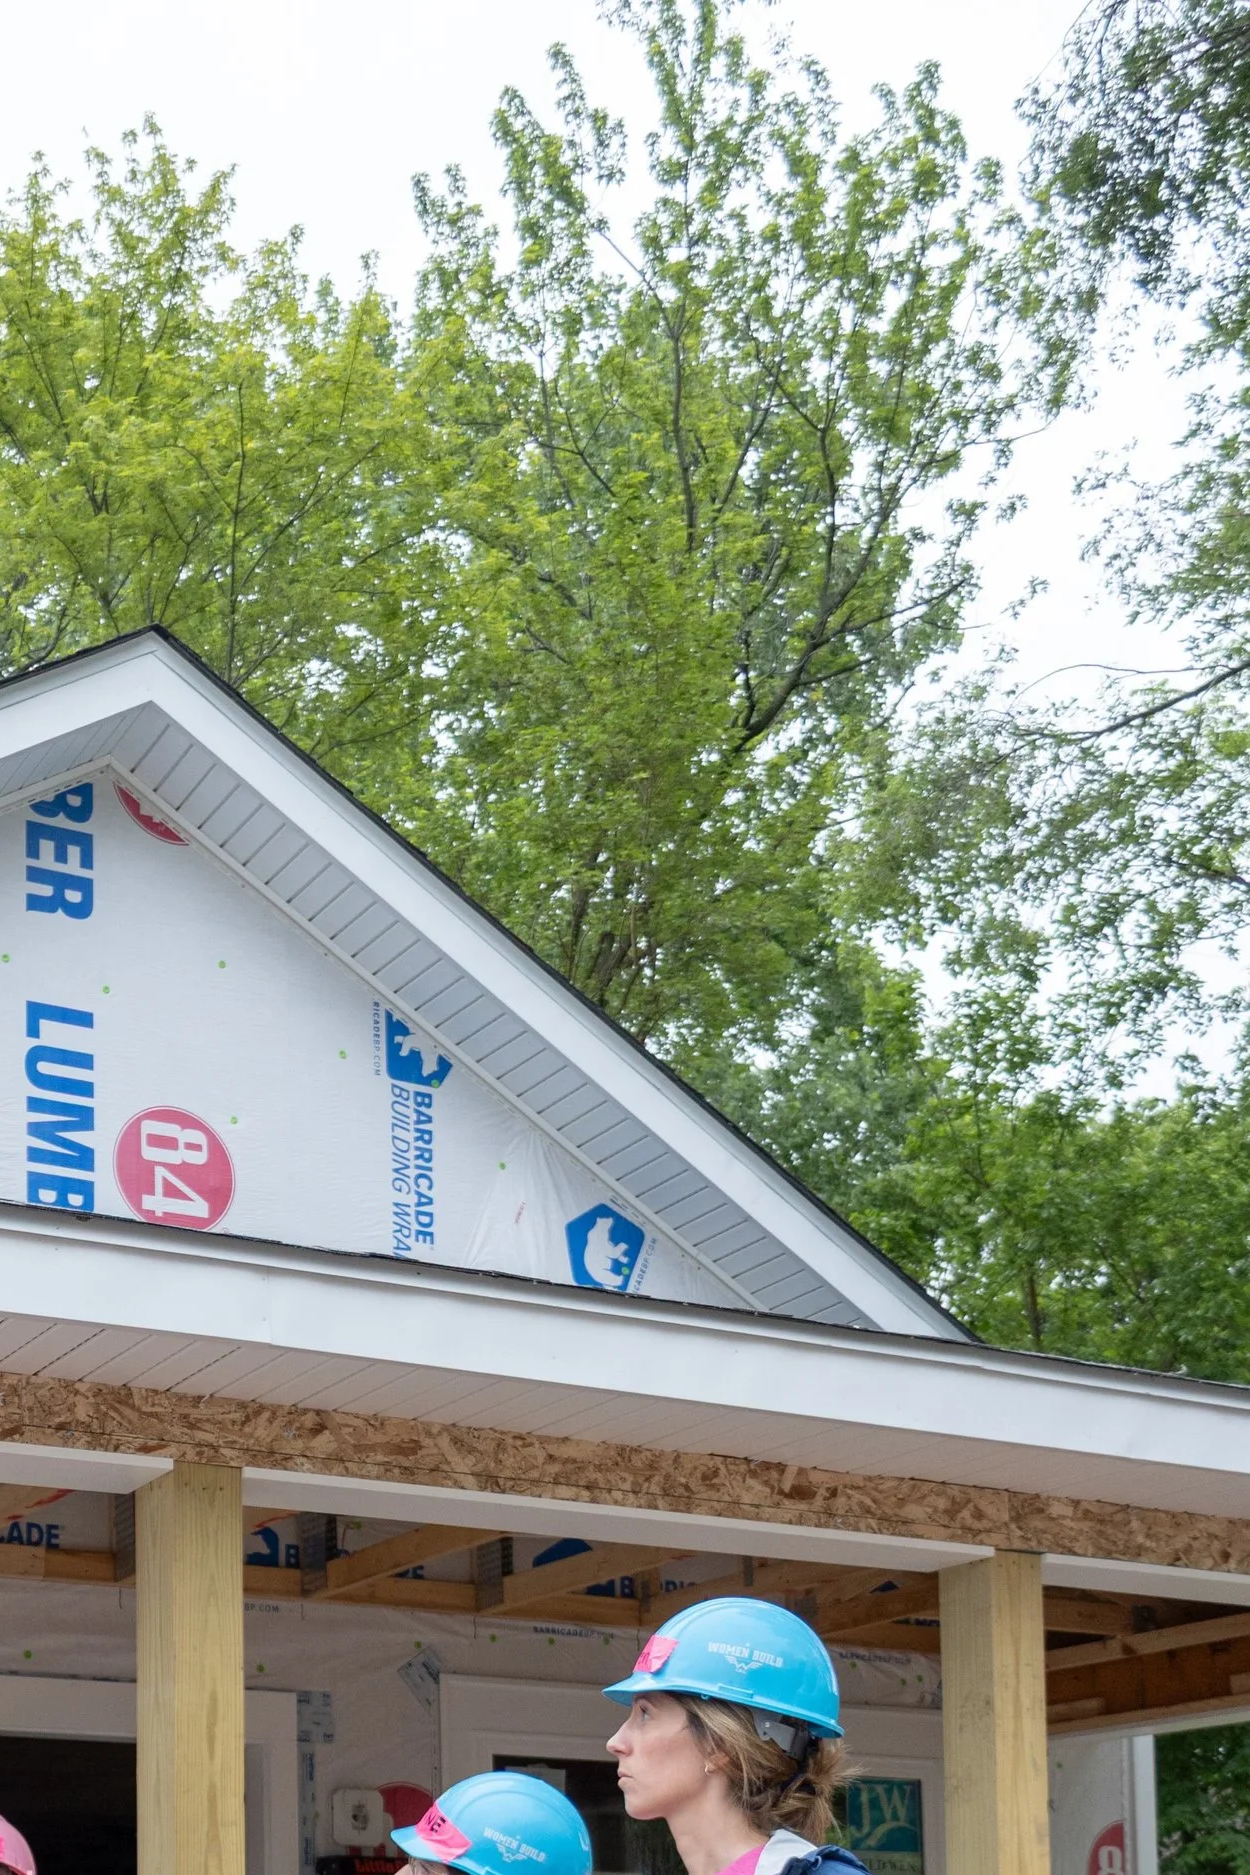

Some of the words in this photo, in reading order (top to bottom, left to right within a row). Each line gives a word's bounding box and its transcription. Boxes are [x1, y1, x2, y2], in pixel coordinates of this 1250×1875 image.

[26, 782, 93, 920] BER
[25, 1000, 94, 1213] LUMB
[391, 1083, 411, 1195] BUILDING
[141, 1119, 209, 1219] 84
[413, 1091, 434, 1246] BARRICADE
[708, 1641, 750, 1658] WOMEN
[752, 1650, 784, 1669] BUILD
[483, 1827, 519, 1850] WOMEN
[519, 1845, 547, 1863] BUILD
